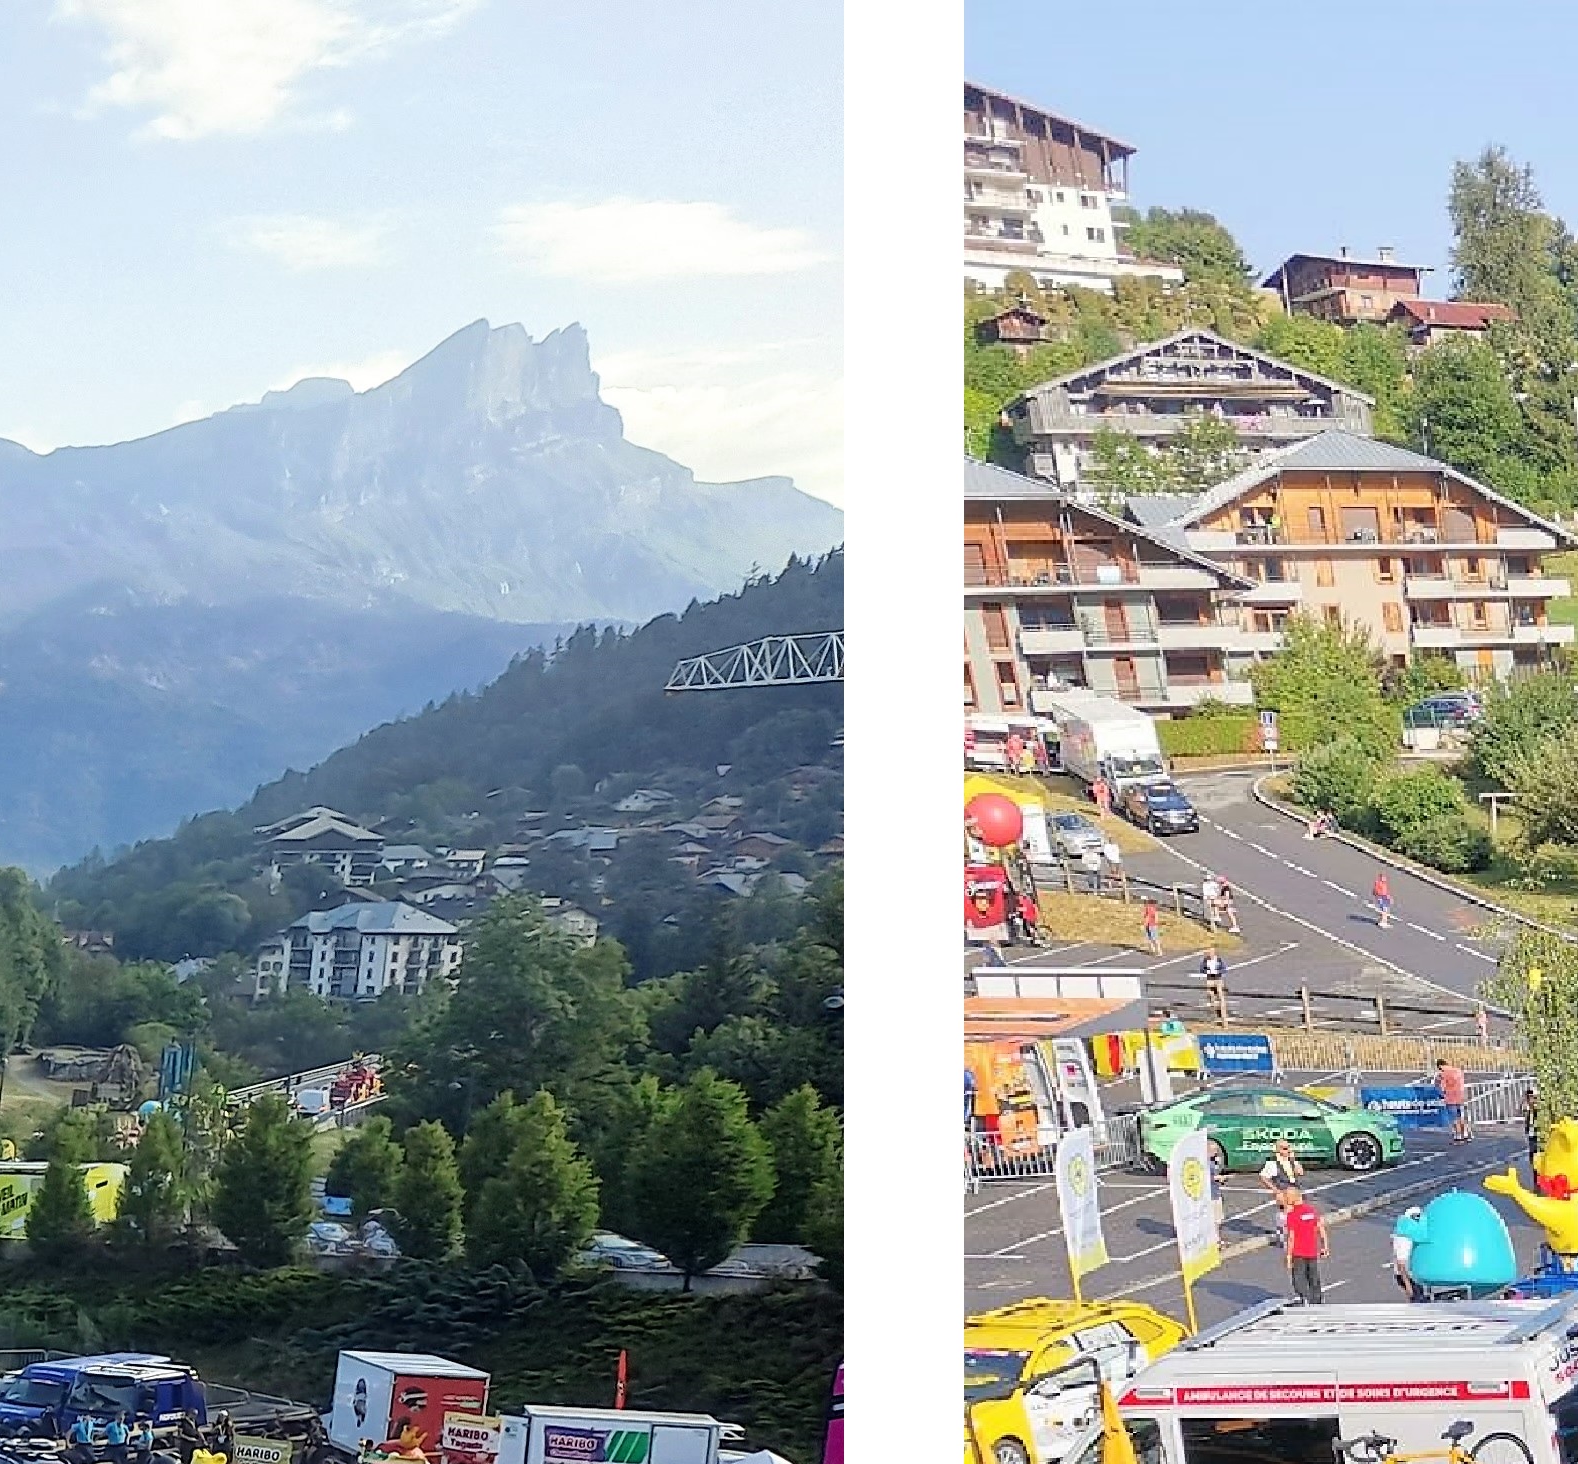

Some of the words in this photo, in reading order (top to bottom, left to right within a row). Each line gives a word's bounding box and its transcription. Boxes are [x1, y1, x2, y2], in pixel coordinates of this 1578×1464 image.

[1243, 1127, 1314, 1140] SKODA
[1183, 1388, 1254, 1402] AMBULANCE
[1255, 1388, 1269, 1401] DE
[1270, 1387, 1321, 1401] SECOURS
[1323, 1388, 1335, 1400] ET
[1354, 1387, 1391, 1400] SOINS
[1392, 1386, 1459, 1399] D'URGENCE
[448, 1425, 489, 1442] HARIBO
[549, 1435, 595, 1450] HARIBO
[235, 1446, 281, 1462] HARIBO
